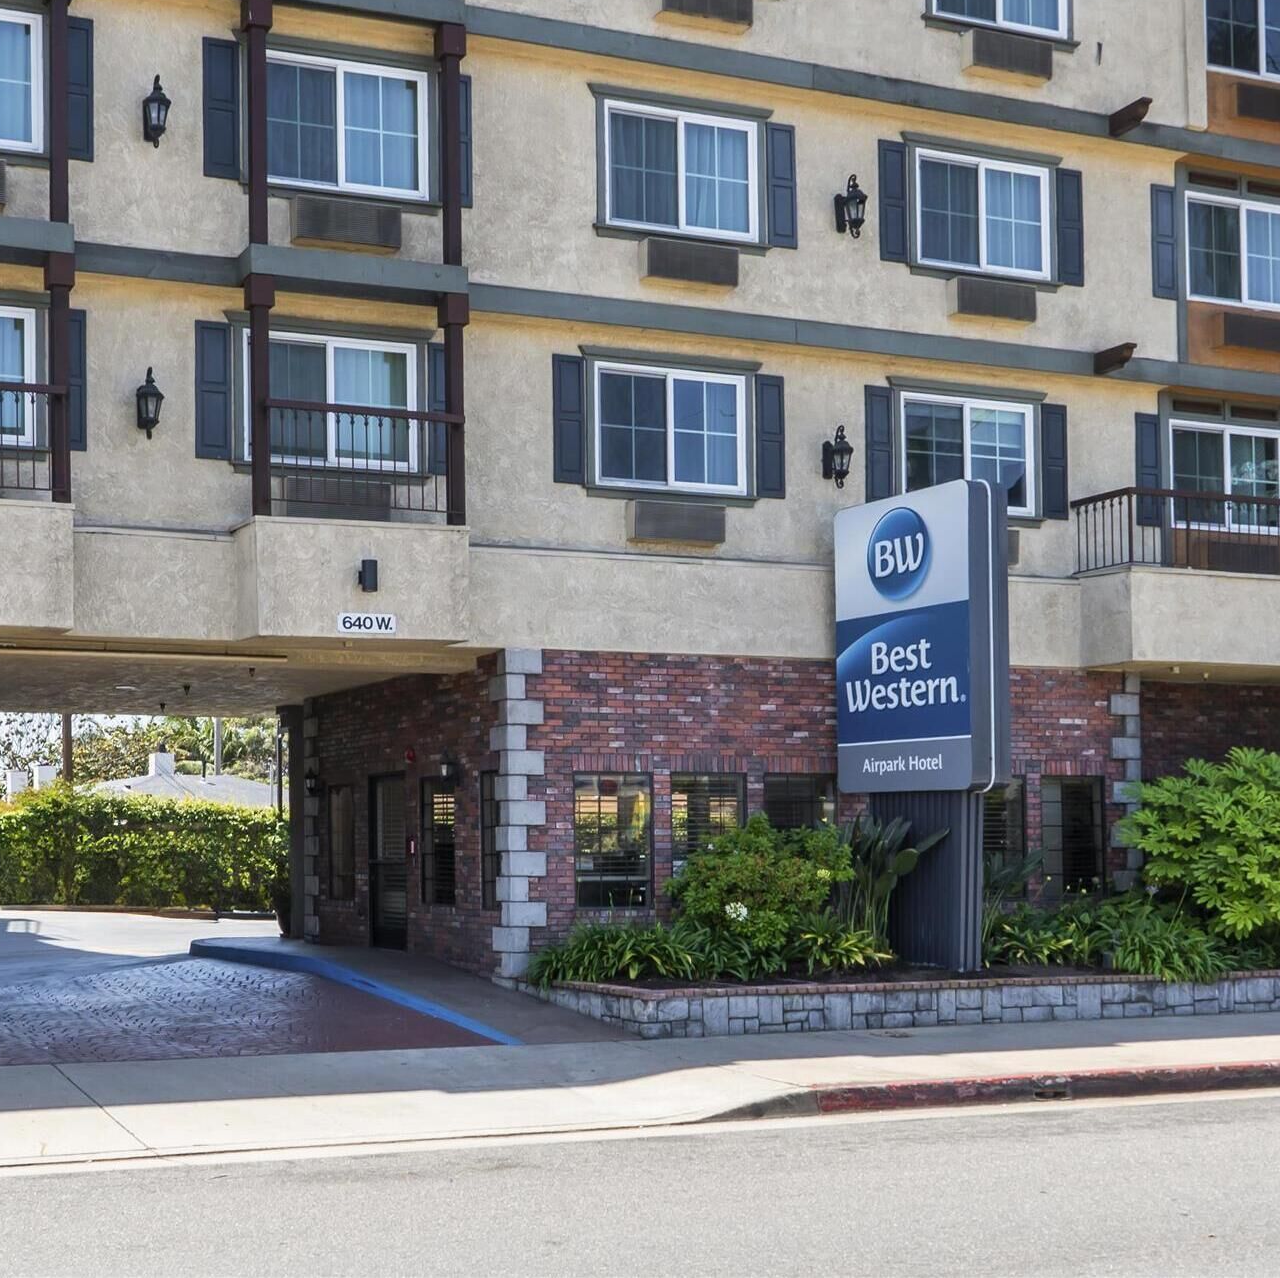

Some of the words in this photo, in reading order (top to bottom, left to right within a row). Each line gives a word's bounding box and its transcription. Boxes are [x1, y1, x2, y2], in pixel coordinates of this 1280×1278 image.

[874, 532, 924, 579] BW
[342, 615, 374, 630] 640
[375, 616, 393, 630] W.
[871, 638, 932, 676] Best
[862, 756, 906, 776] Airpark
[908, 753, 943, 772] Hotel
